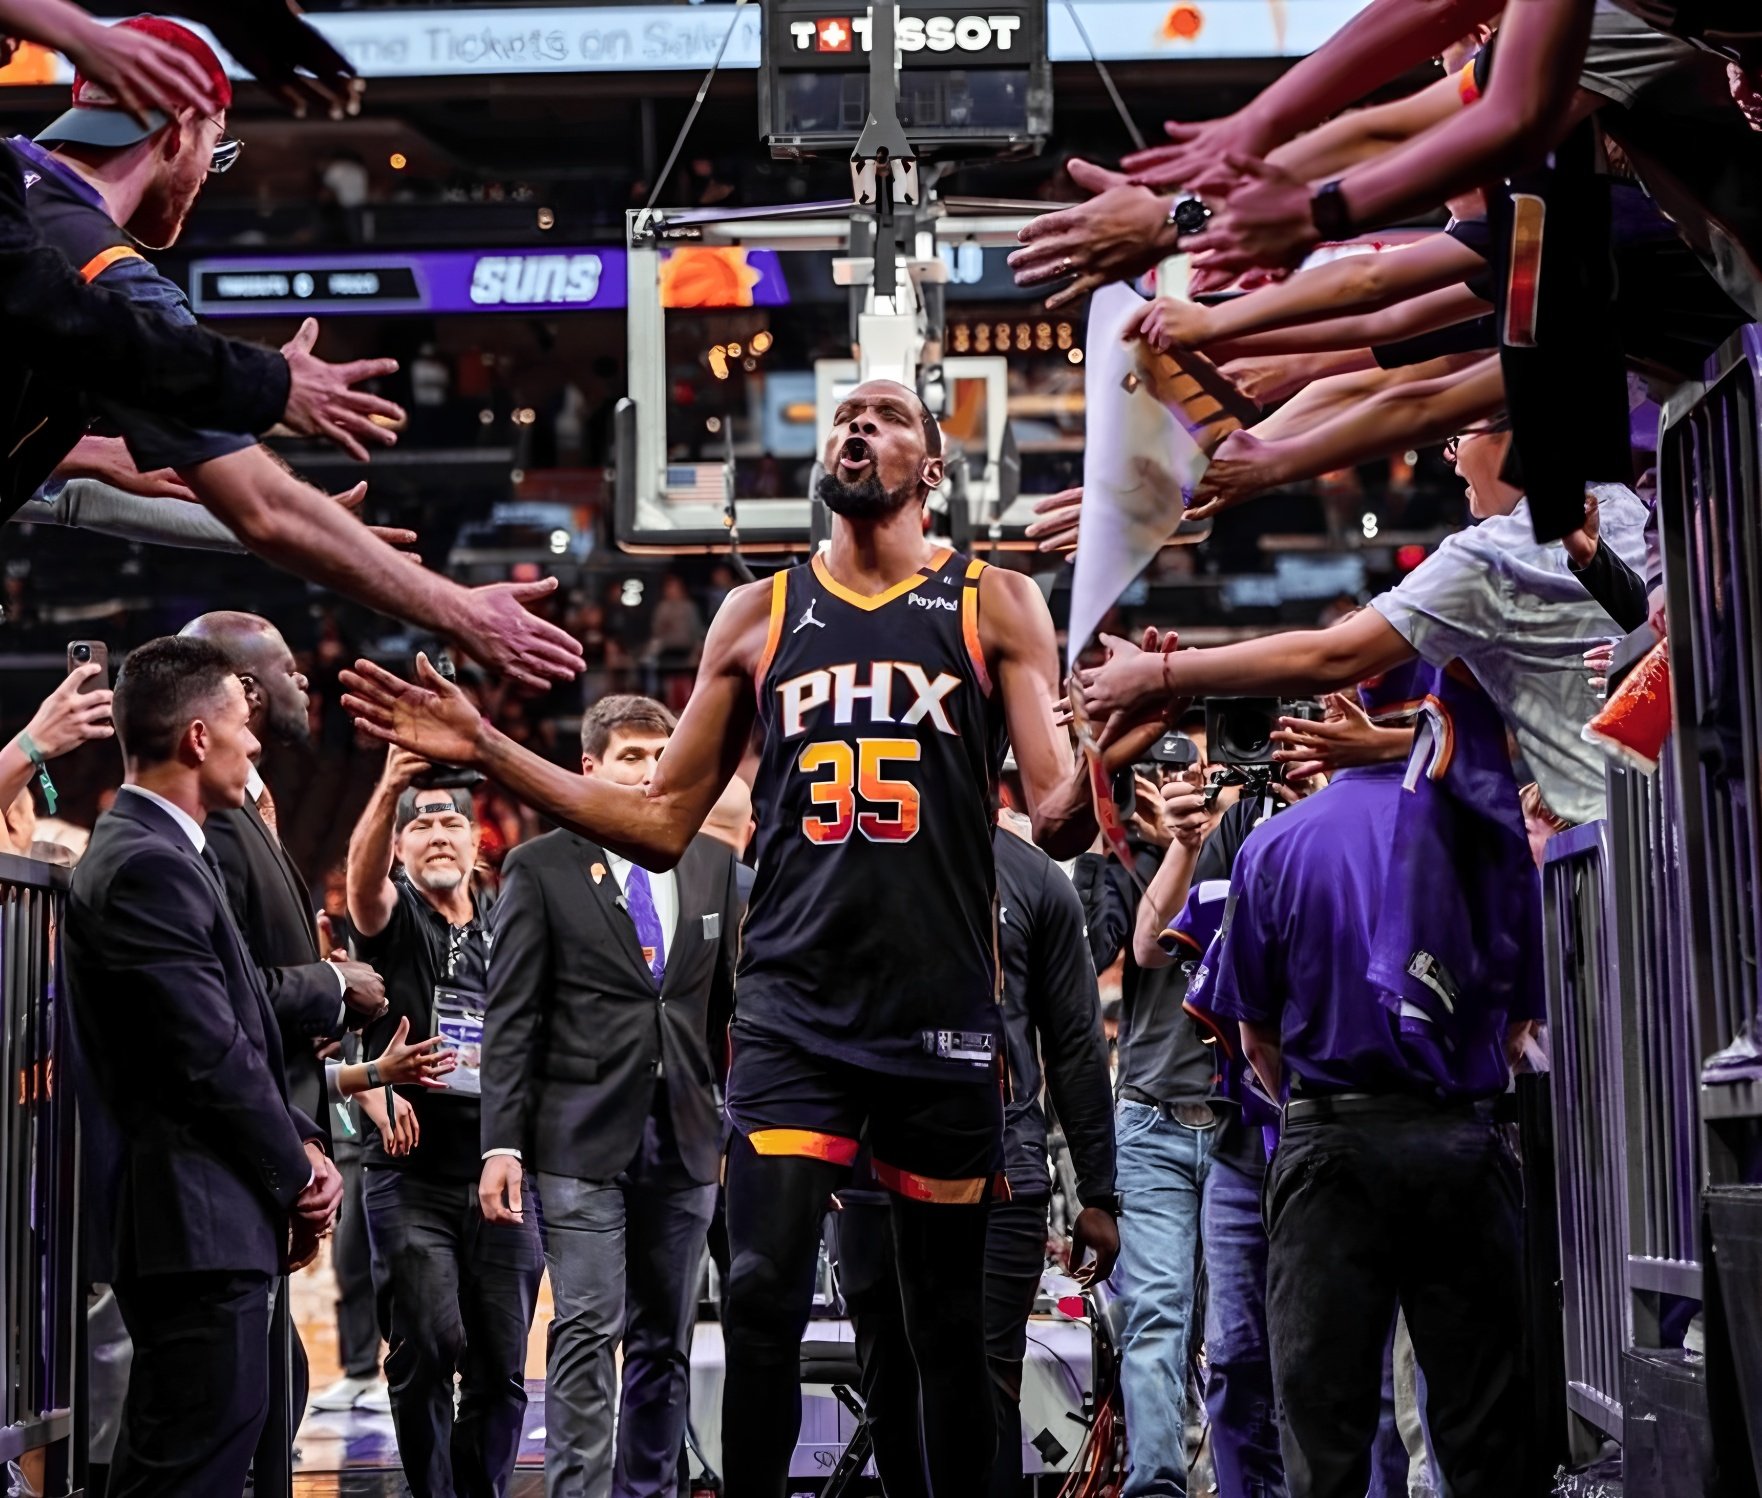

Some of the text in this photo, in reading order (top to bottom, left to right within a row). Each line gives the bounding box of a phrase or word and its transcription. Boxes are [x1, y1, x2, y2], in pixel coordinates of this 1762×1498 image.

[579, 28, 634, 62] on
[853, 15, 1020, 52] TSSOT
[775, 660, 962, 737] PHX
[799, 738, 921, 845] 35
